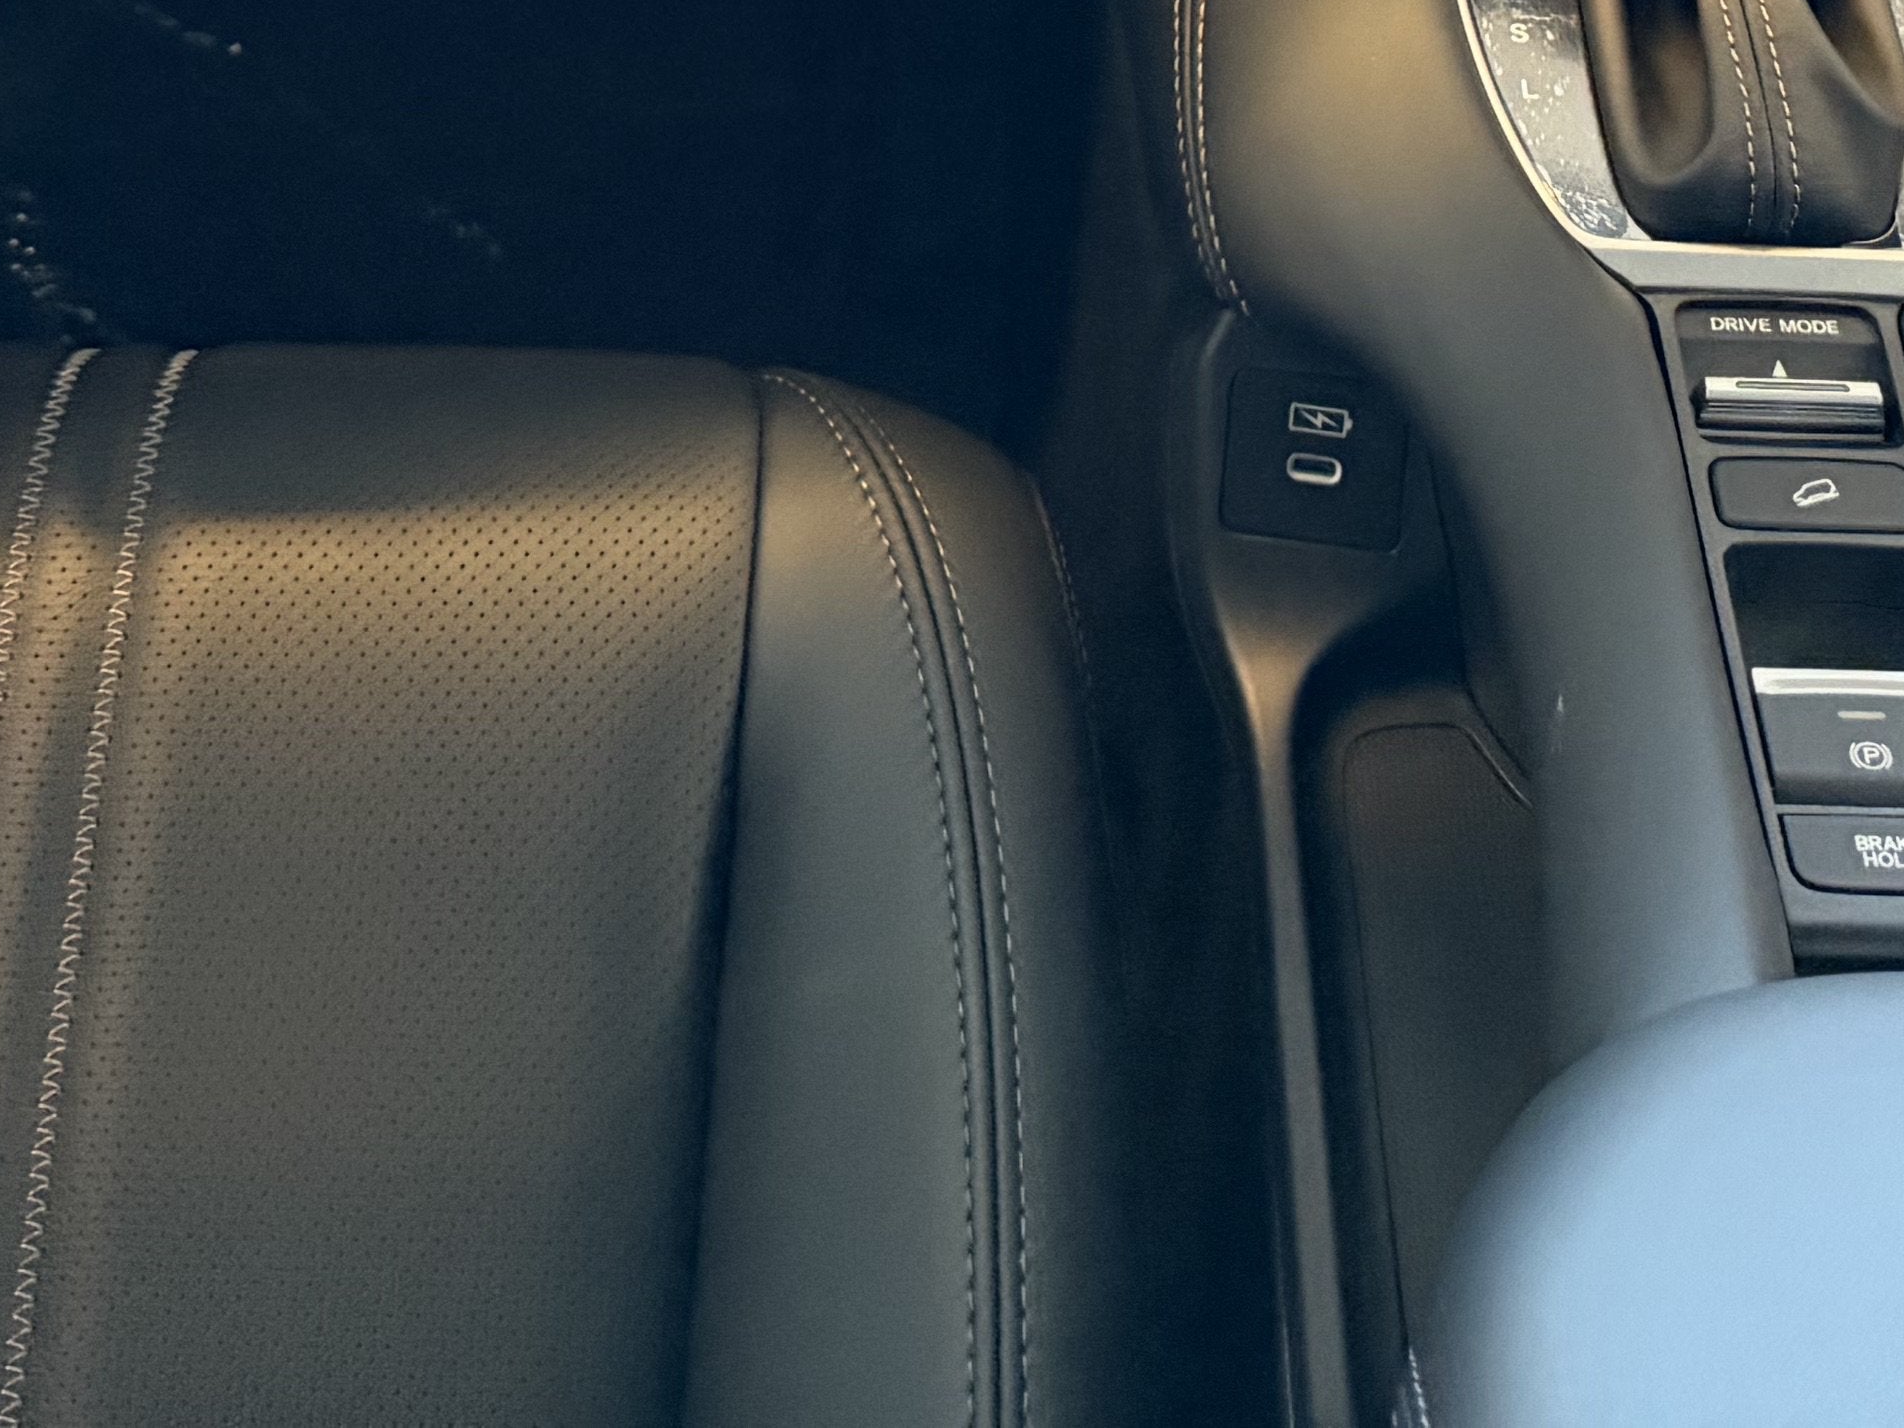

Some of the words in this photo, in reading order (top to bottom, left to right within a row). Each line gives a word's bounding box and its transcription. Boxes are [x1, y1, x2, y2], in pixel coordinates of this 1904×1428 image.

[1510, 23, 1530, 43] S
[1521, 79, 1539, 100] L
[1710, 316, 1772, 333] DRIVE
[1779, 318, 1840, 335] MODE
